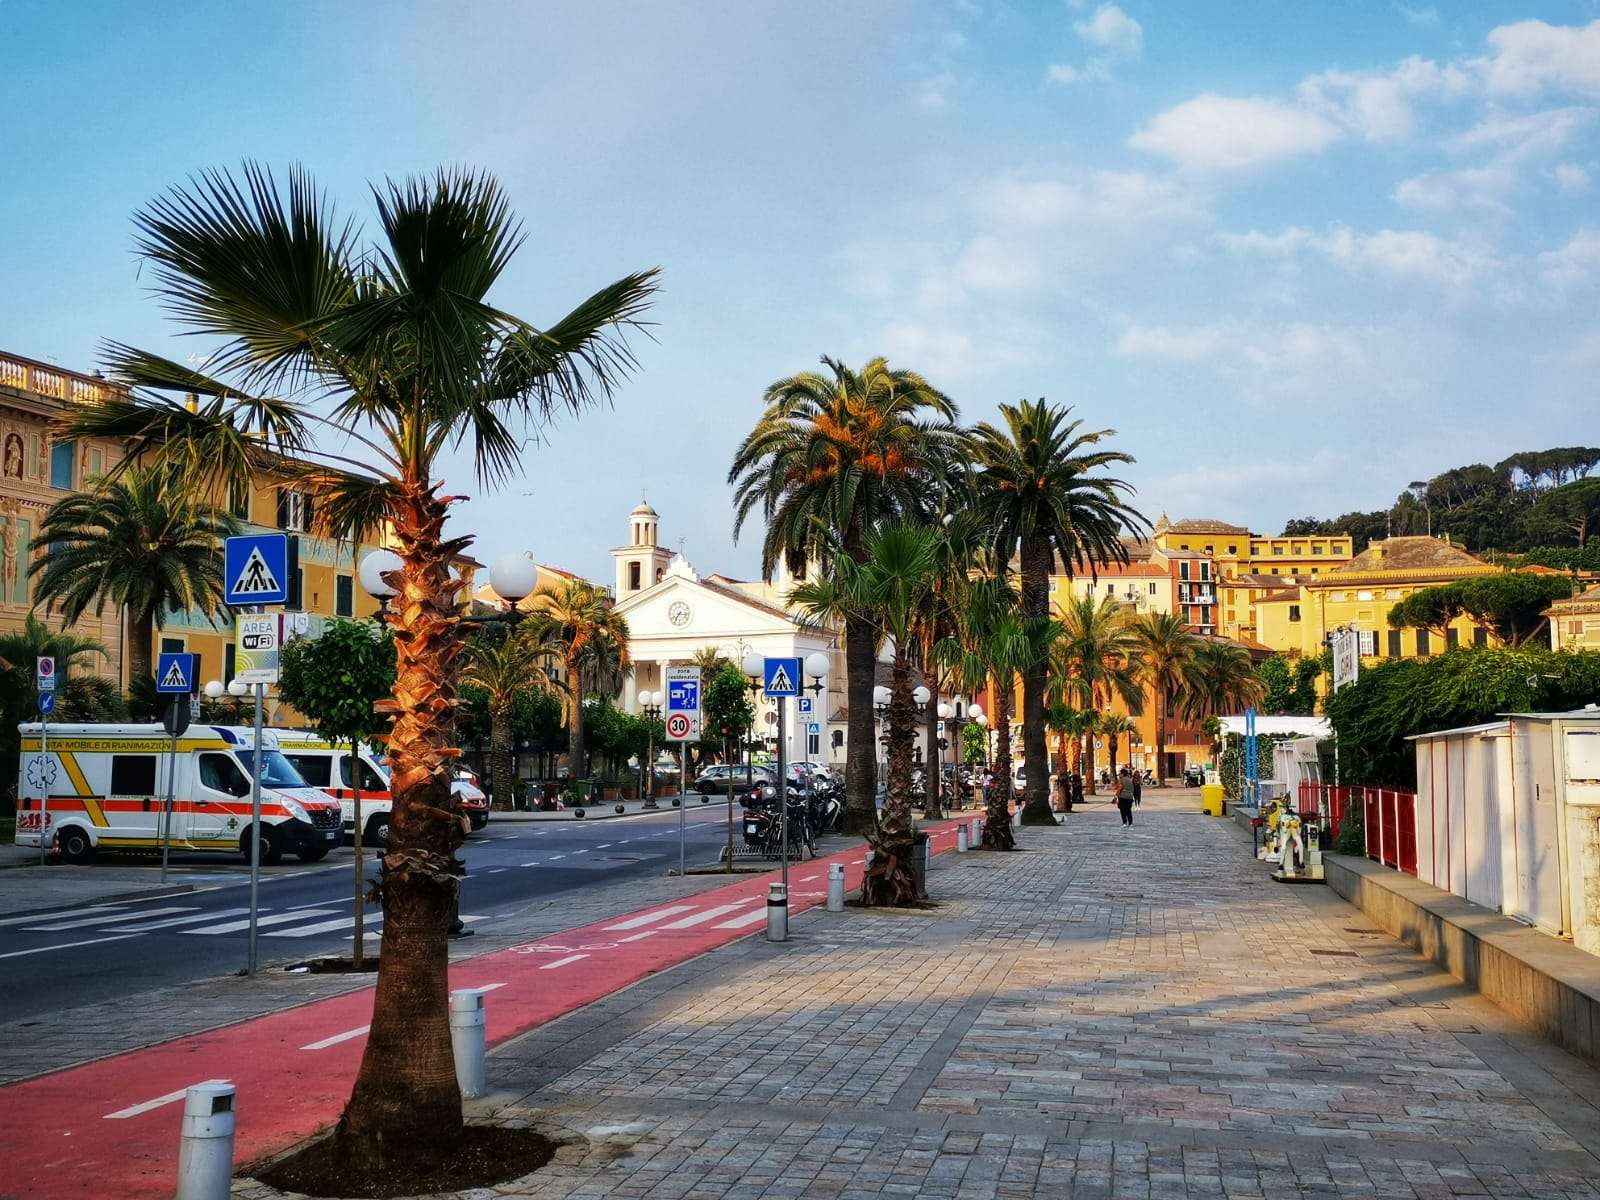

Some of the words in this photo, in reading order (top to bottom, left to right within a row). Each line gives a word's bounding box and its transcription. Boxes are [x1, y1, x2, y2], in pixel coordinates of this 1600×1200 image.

[244, 622, 273, 633] AREA
[801, 700, 809, 710] P
[672, 720, 685, 731] 30
